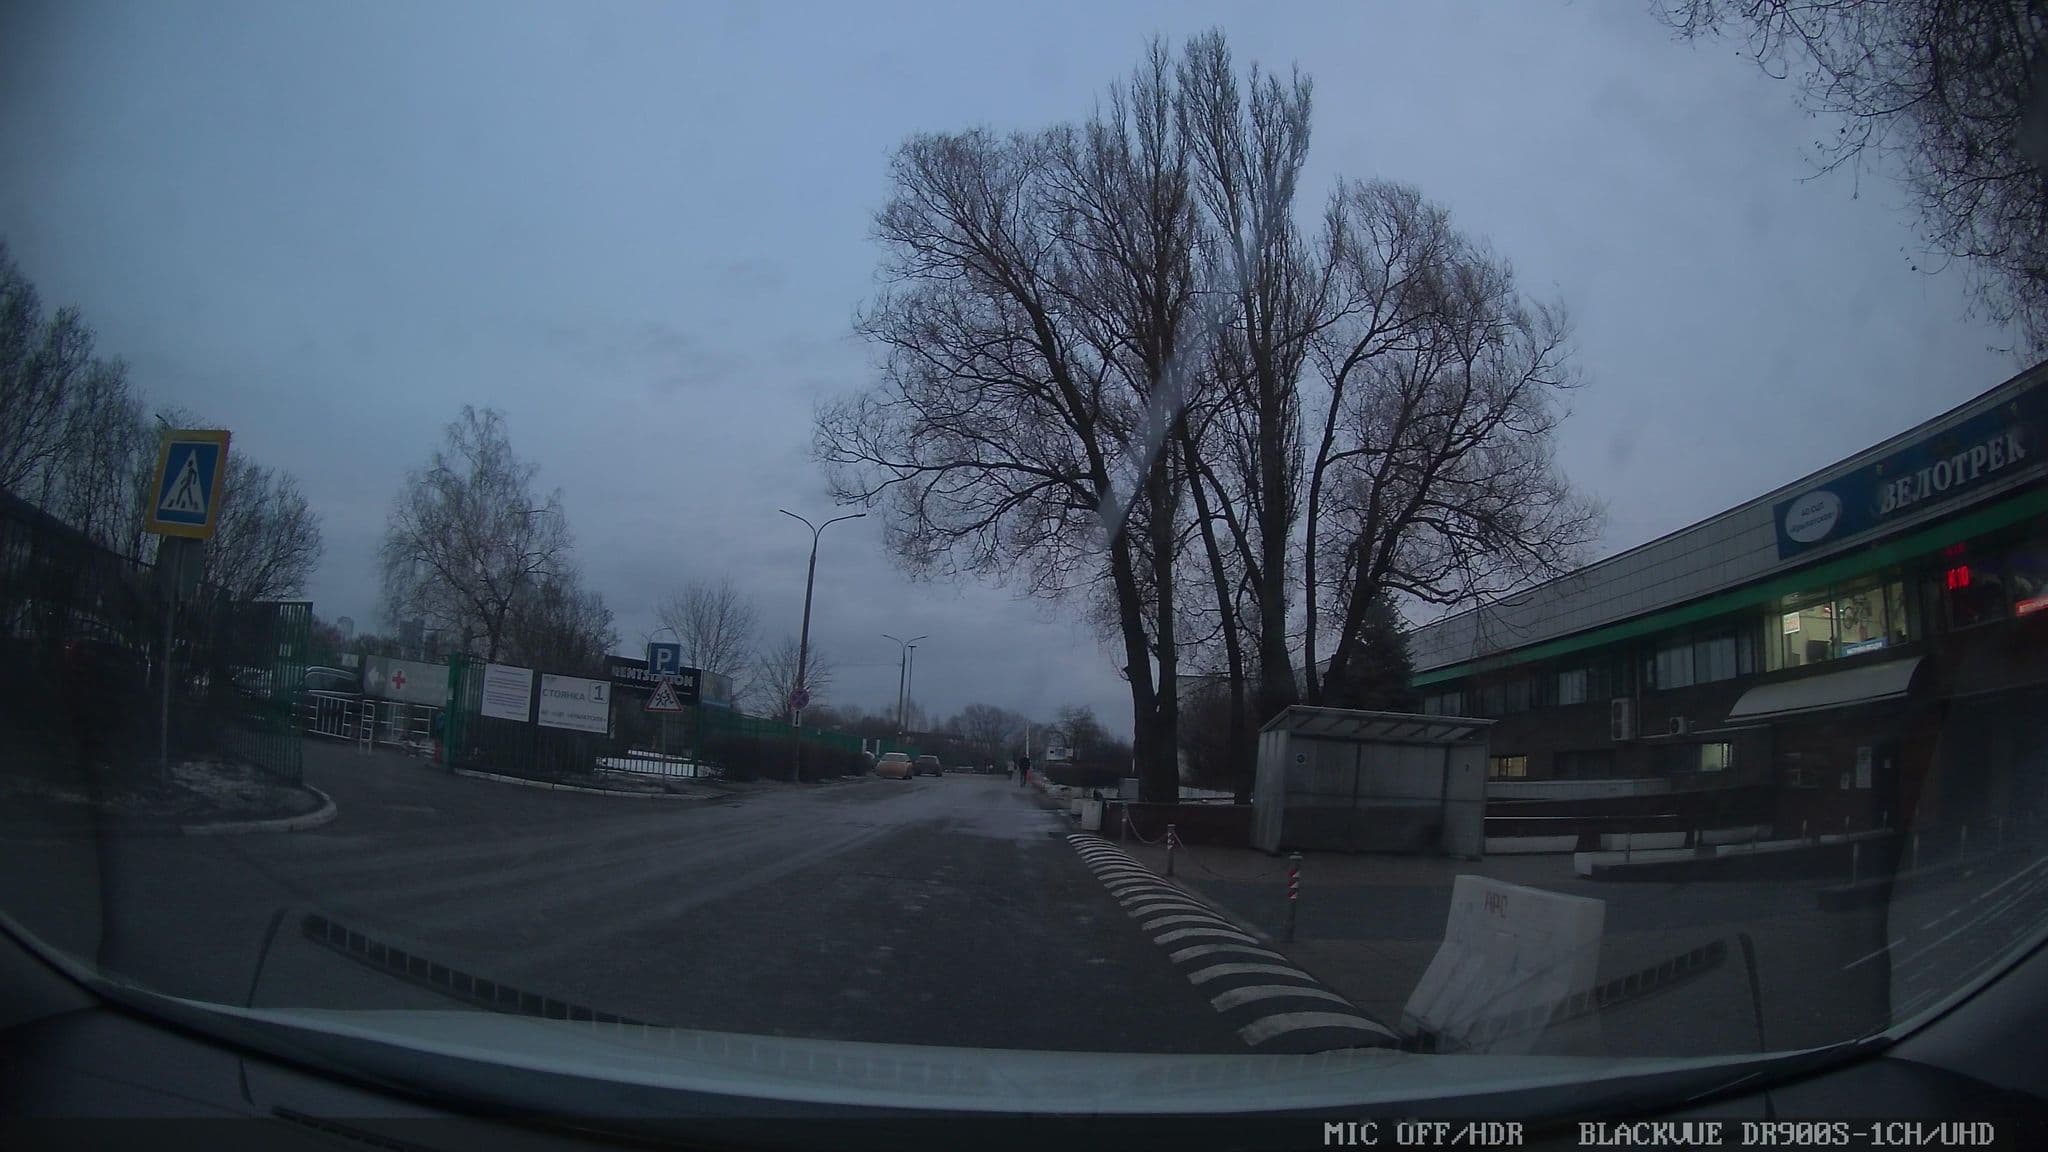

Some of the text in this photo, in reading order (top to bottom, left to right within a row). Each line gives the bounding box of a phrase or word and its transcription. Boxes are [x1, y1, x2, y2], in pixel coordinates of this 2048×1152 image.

[1880, 430, 2026, 515] ВЕЛОТРЕК
[656, 648, 672, 671] P
[542, 688, 585, 701] СТОЯНКА
[594, 685, 604, 701] 1
